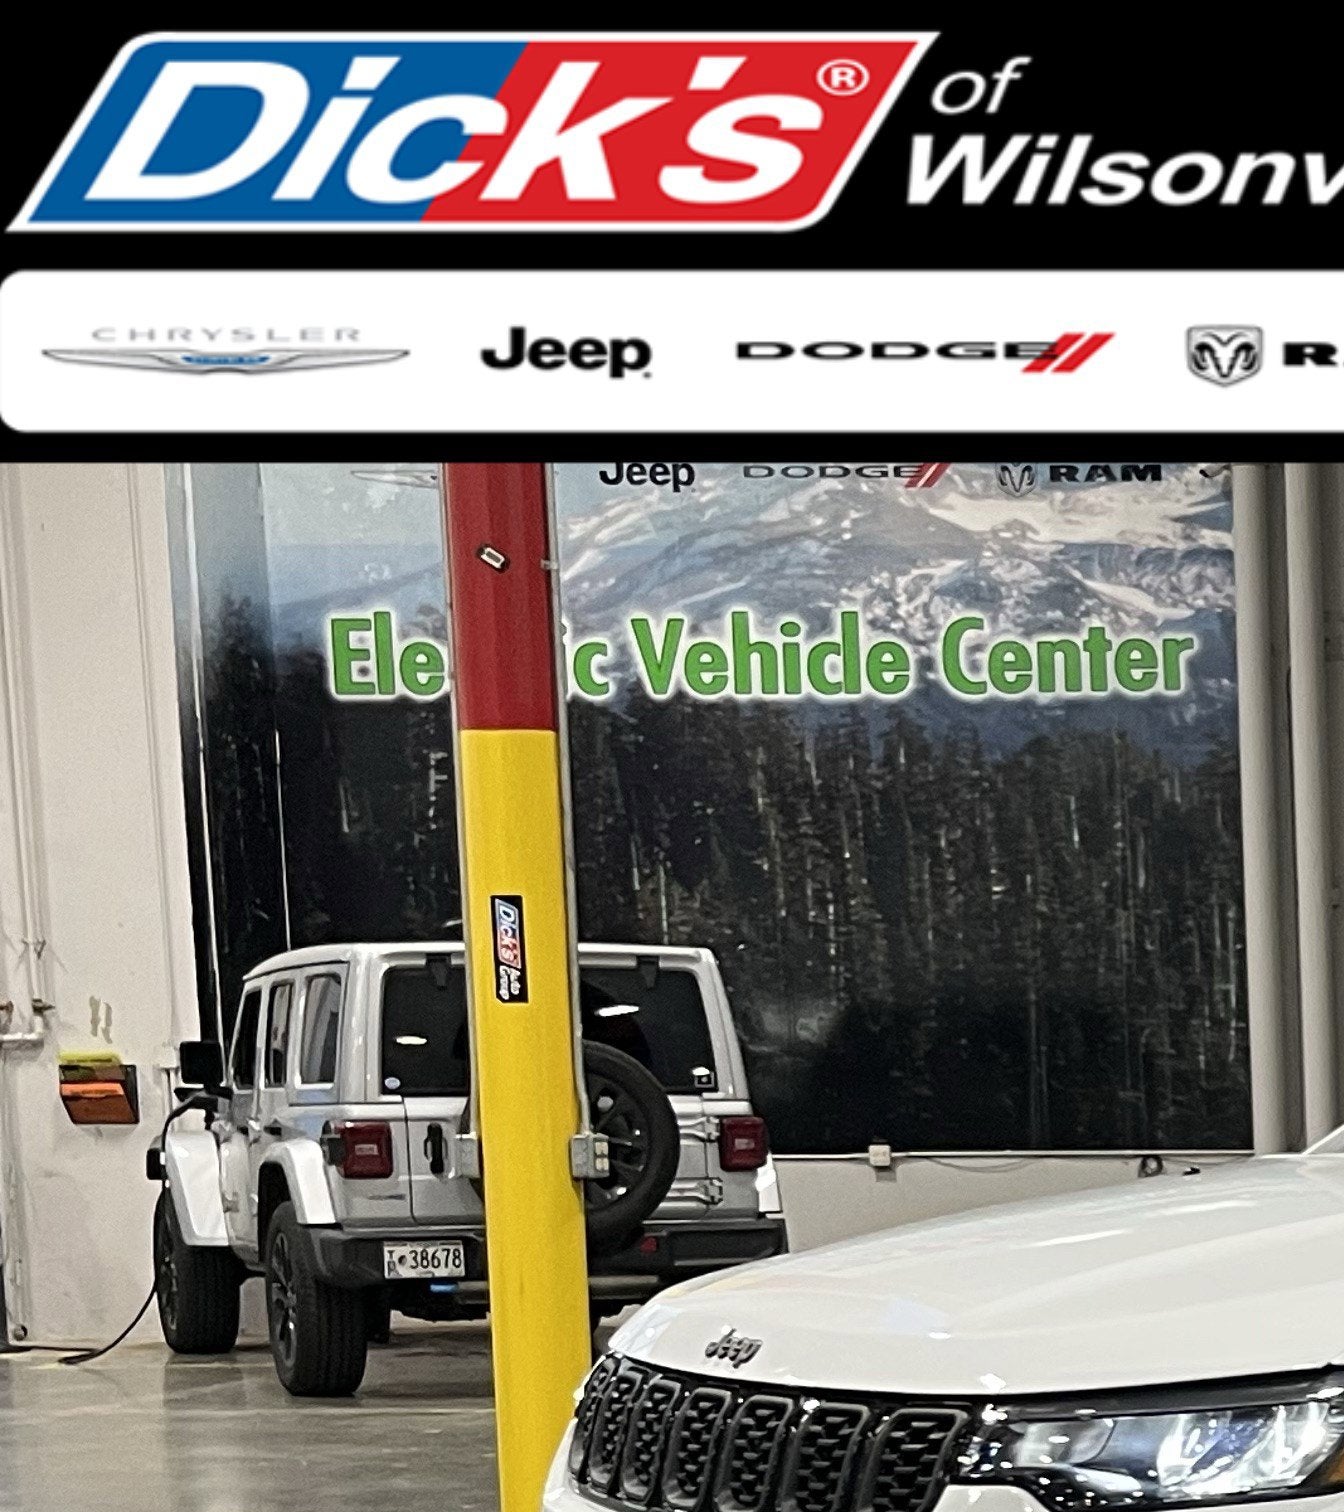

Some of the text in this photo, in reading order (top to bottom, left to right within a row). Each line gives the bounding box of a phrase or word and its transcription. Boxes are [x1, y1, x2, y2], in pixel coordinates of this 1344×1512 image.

[599, 463, 695, 492] Jeep
[743, 464, 925, 479] DODGE
[1050, 464, 1162, 482] RAM
[629, 611, 910, 696] Vehicle
[942, 616, 1195, 696] Center
[408, 1248, 463, 1270] 38678
[705, 1328, 763, 1369] Jeep
